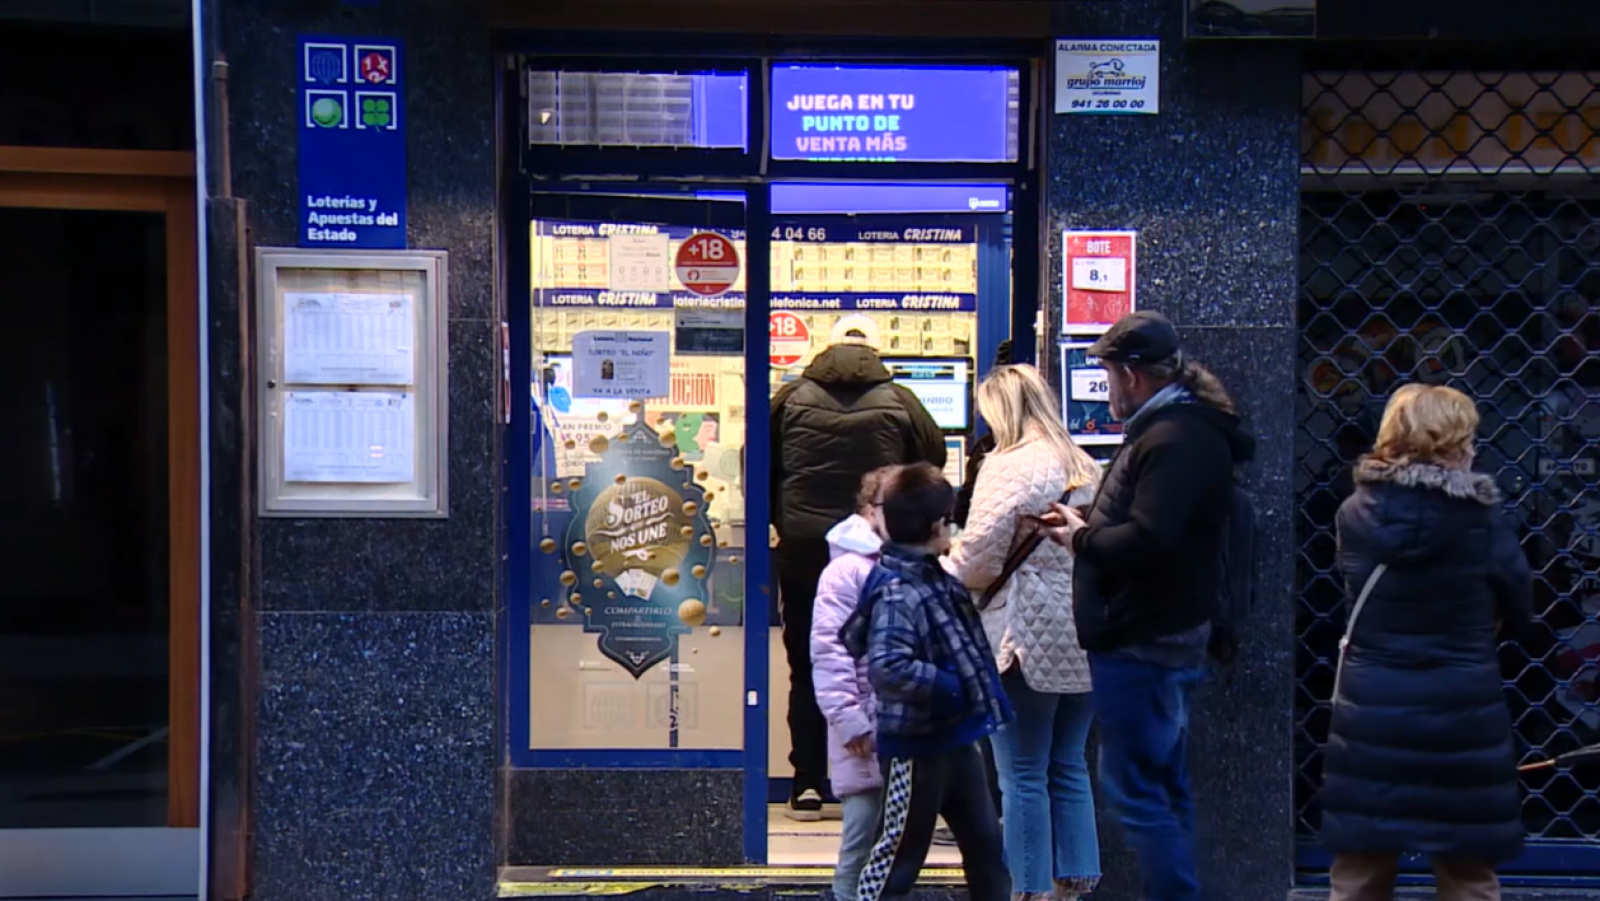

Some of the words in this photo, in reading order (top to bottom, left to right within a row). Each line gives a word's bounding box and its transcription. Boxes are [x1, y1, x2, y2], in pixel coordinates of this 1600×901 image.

[1058, 43, 1098, 52] ALARMA
[1100, 43, 1157, 52] CONECTADA
[1066, 78, 1101, 90] grupo
[786, 94, 853, 111] JUEGA
[857, 94, 885, 111] EN
[888, 94, 915, 110] TU
[1071, 99, 1092, 108] 941
[1095, 99, 1110, 109] 26
[1112, 99, 1128, 109] 00
[1130, 99, 1146, 109] 00
[803, 115, 870, 132] PUNTO
[874, 115, 901, 131] DE
[796, 135, 862, 152] VENTA
[866, 132, 908, 151] MÁS
[307, 195, 366, 209] Loterías
[368, 198, 378, 212] y
[308, 211, 375, 227] Apuestas
[376, 211, 399, 226] del
[307, 227, 357, 242] Estado
[552, 225, 595, 235] LOTERIA
[598, 223, 659, 236] CRISTINA
[785, 227, 804, 241] 04
[808, 228, 827, 241] 66
[858, 231, 900, 241] LOTERIA
[903, 228, 963, 242] CRISTINA
[687, 238, 725, 261] +18
[1086, 240, 1112, 254] BOTE
[551, 293, 594, 305] LOTERIA
[597, 291, 657, 306] CRISTINA
[856, 298, 899, 309] LOTERIA
[902, 295, 961, 309] CRISTINA
[593, 387, 604, 395] VA
[613, 387, 624, 395] LA
[625, 387, 652, 396] VENTA
[604, 494, 669, 529] SORTEO
[610, 533, 637, 555] NOS
[638, 522, 668, 546] UNE
[604, 606, 674, 616] COMPARTIRLO
